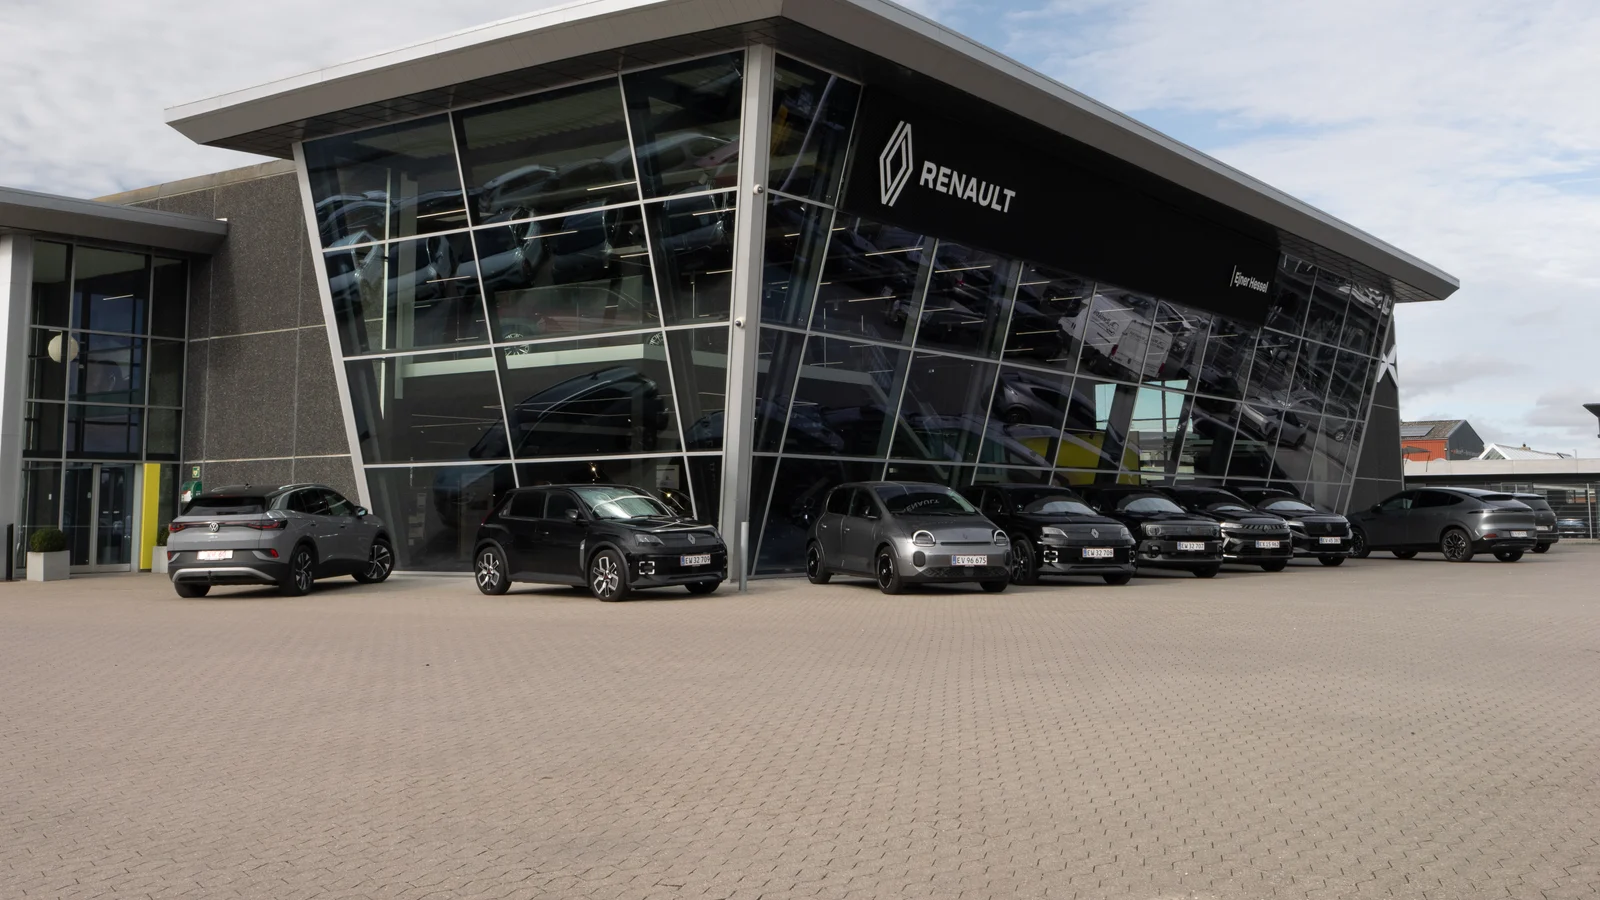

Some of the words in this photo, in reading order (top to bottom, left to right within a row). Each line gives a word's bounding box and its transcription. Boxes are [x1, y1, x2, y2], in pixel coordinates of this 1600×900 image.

[920, 160, 1016, 213] RENAULT
[1235, 272, 1250, 287] Ejner
[1249, 276, 1269, 293] Hessel
[685, 557, 693, 565] EW
[956, 556, 966, 564] EV
[966, 556, 974, 564] 96
[975, 556, 987, 564] 675
